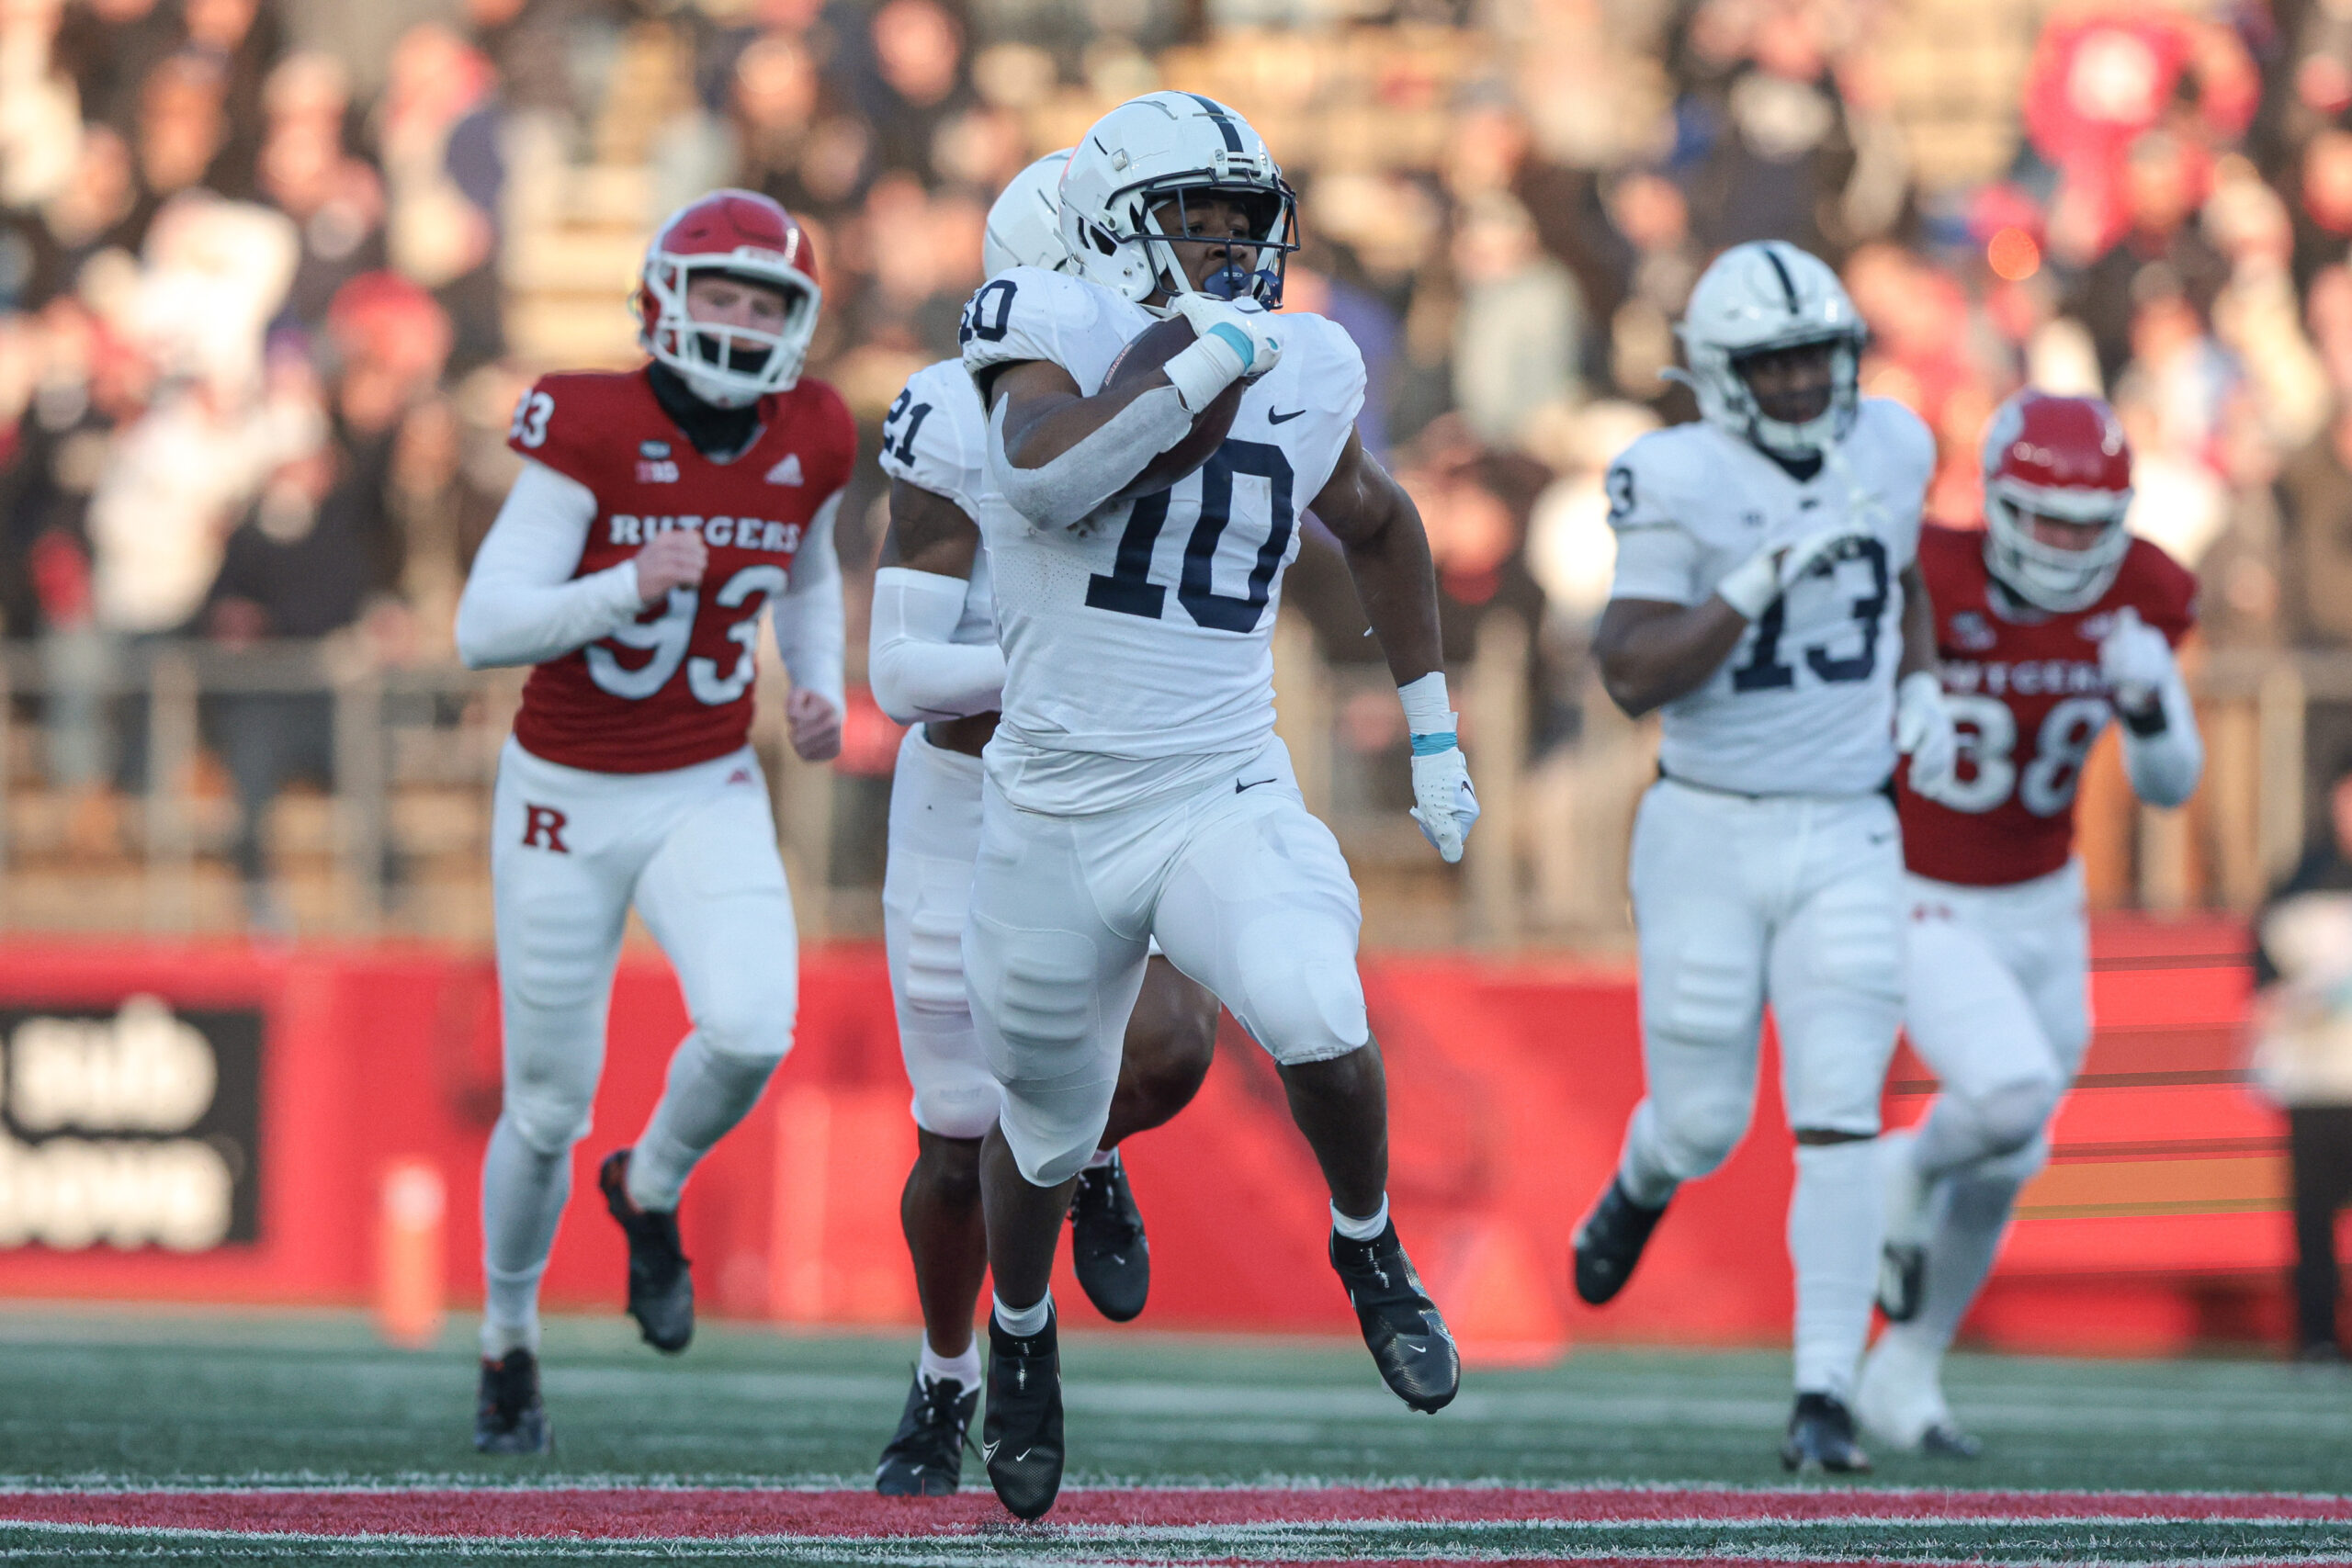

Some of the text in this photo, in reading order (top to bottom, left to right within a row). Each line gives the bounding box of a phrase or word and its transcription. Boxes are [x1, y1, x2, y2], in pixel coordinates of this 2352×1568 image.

[885, 389, 933, 468] 21
[1084, 439, 1295, 633] 10
[585, 565, 786, 705] 93
[1733, 535, 1889, 692] 13
[523, 804, 569, 853] R
